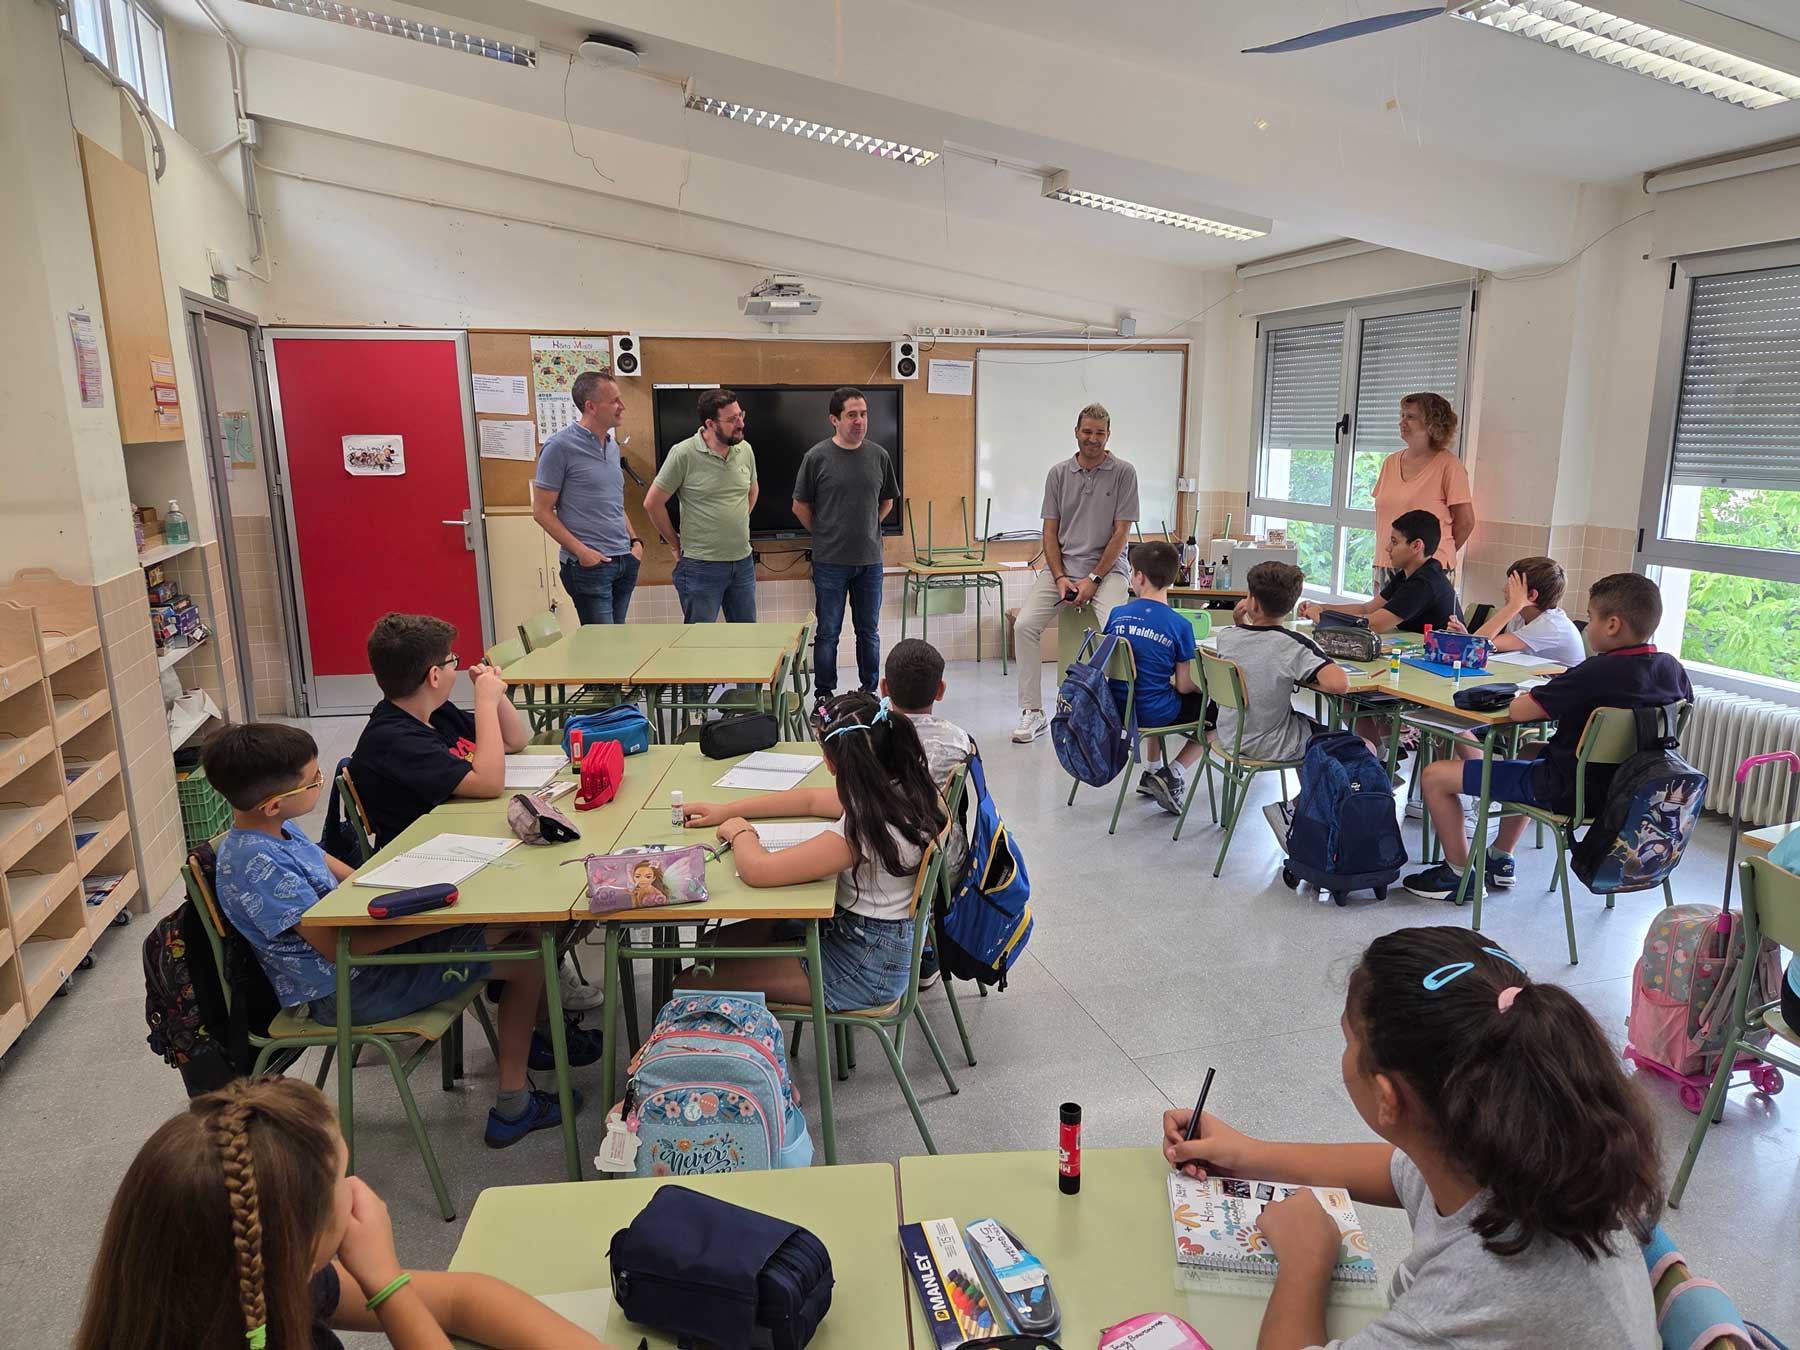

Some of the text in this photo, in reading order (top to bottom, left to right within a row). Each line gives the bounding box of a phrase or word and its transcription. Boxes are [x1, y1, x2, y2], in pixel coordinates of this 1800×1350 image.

[1115, 625, 1173, 647] TC Waldhofen
[915, 1253, 947, 1311] MANLEY
